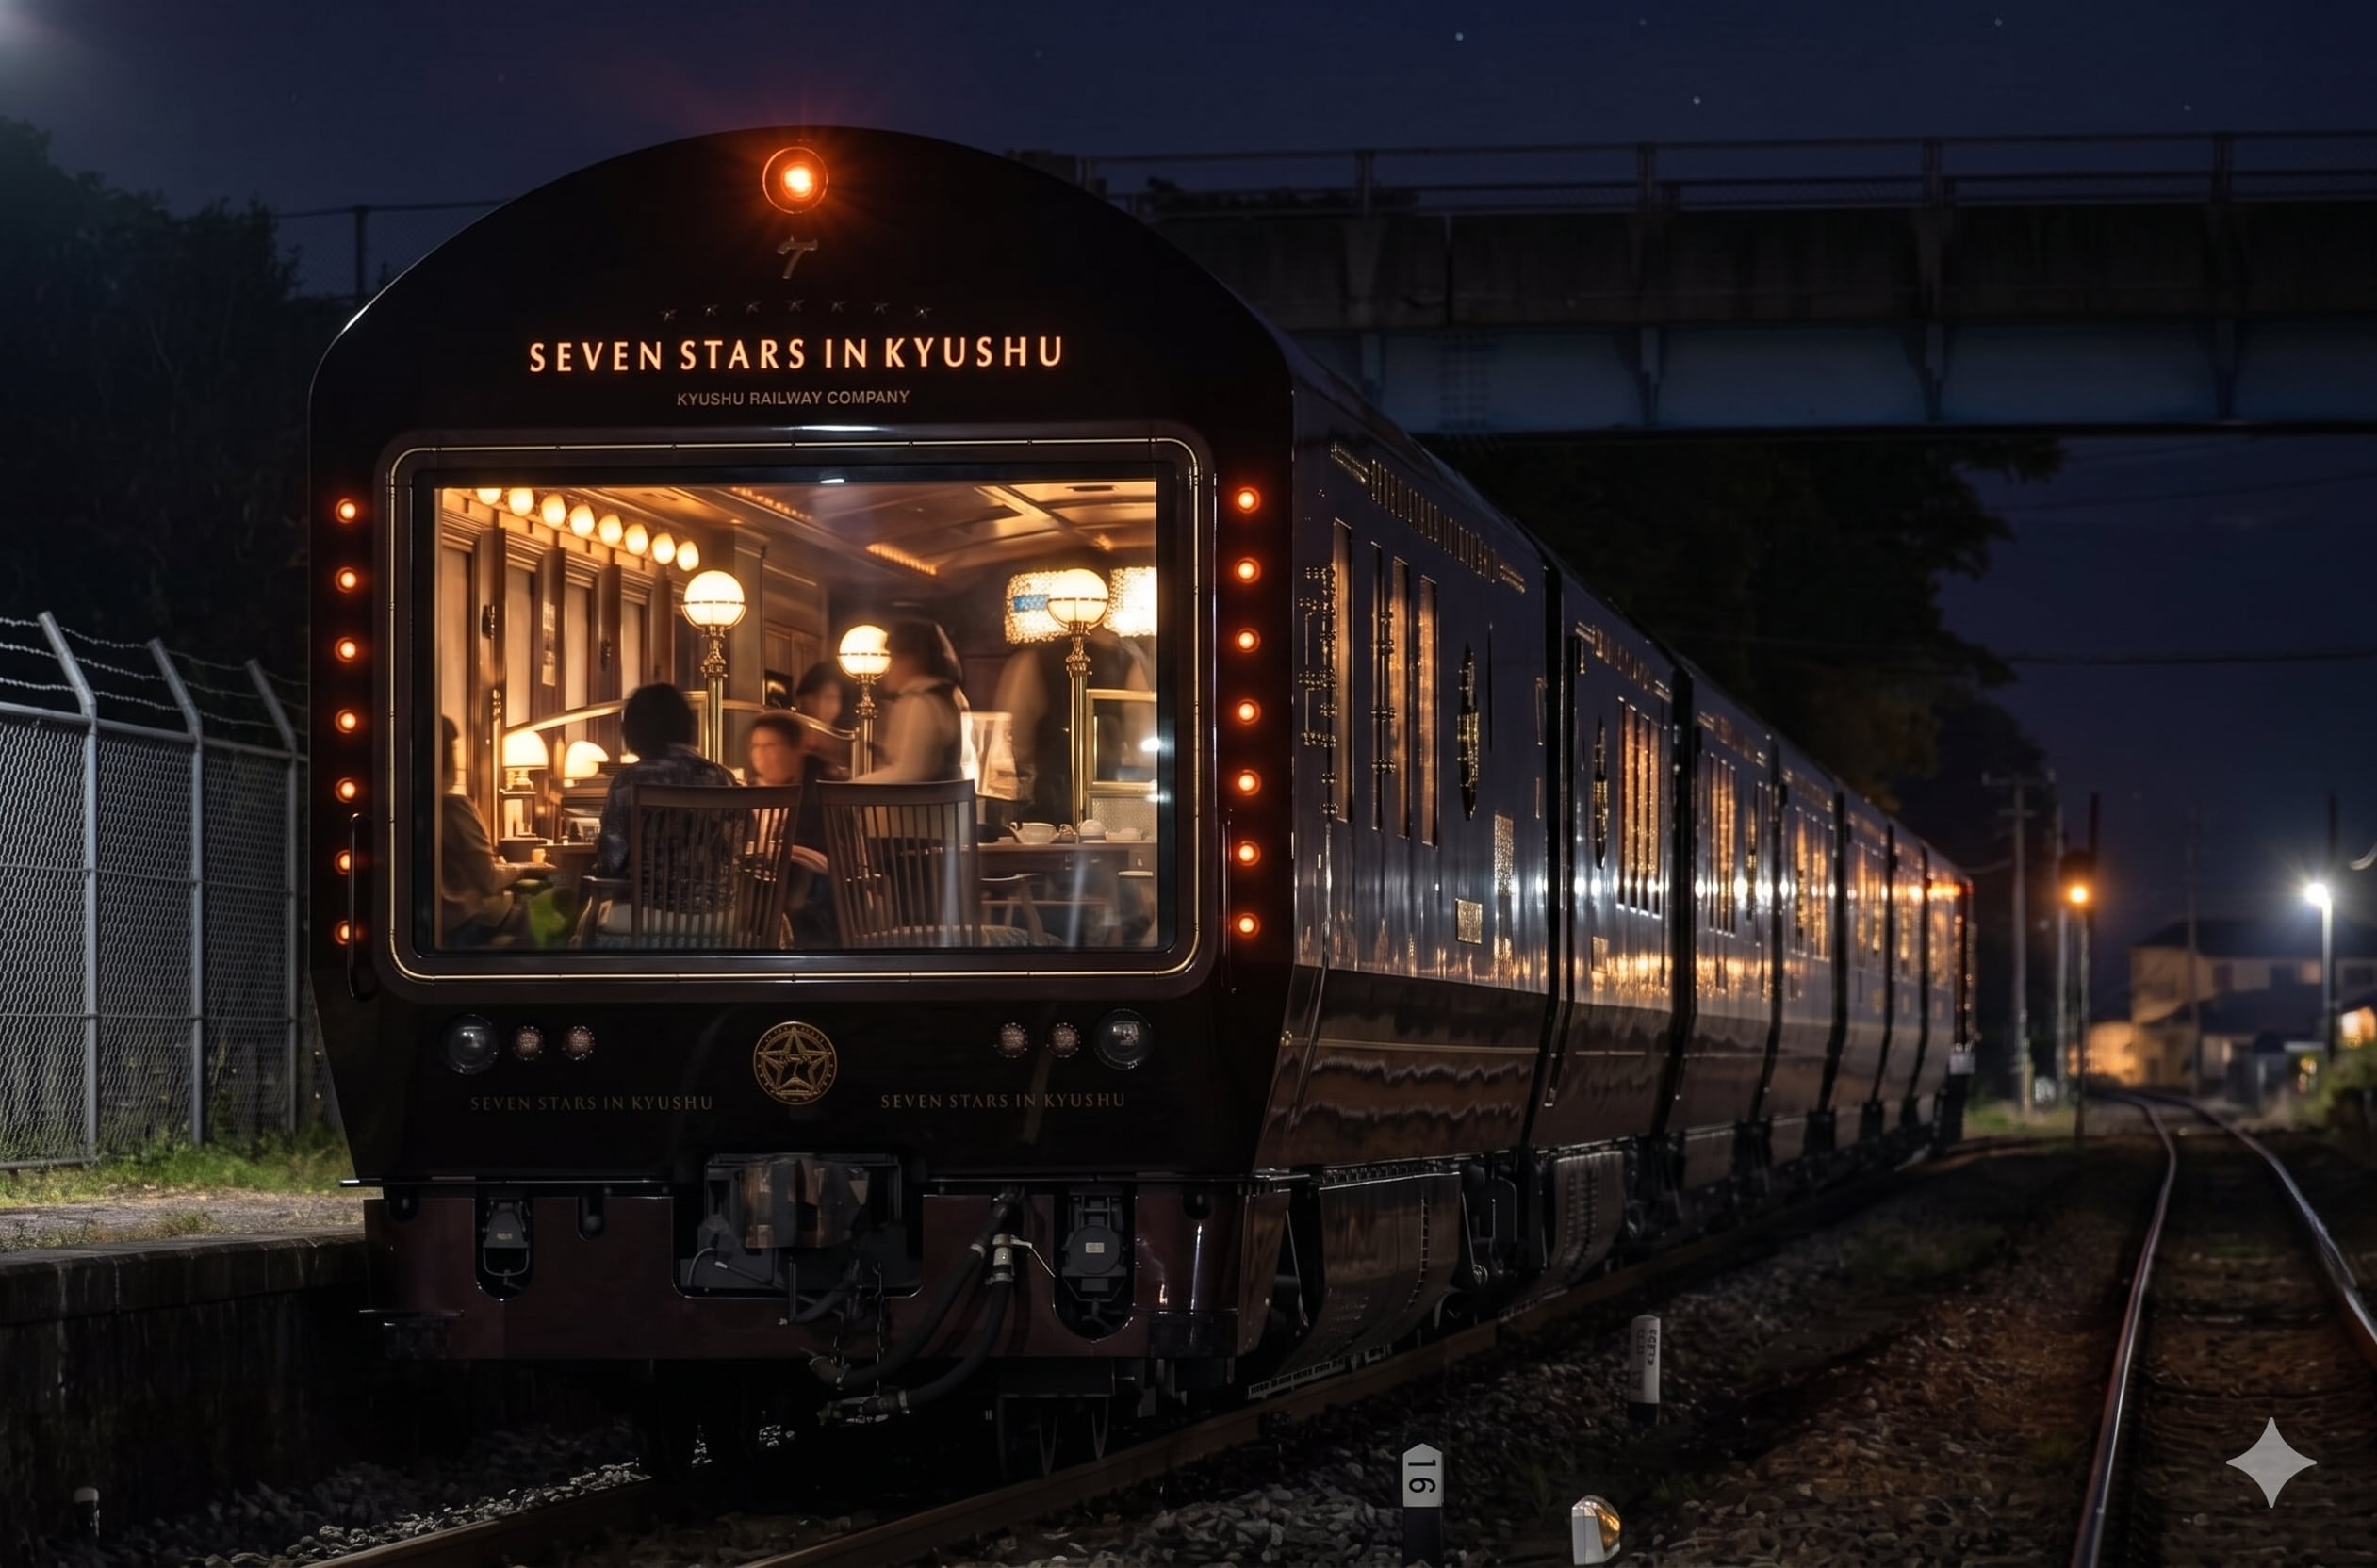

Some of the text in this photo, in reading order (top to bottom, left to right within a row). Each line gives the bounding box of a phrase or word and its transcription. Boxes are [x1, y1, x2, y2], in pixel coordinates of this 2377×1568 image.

[529, 335, 1062, 373] SEVEN STARS IN KYUSHU
[676, 389, 911, 406] KYUSHU RAILWAY COMPANY
[470, 1094, 714, 1112] SEVEN STARS IN KYUSHU
[880, 1091, 1126, 1109] SEVEN STARS IN KYUSHU
[1408, 1459, 1436, 1494] 16
